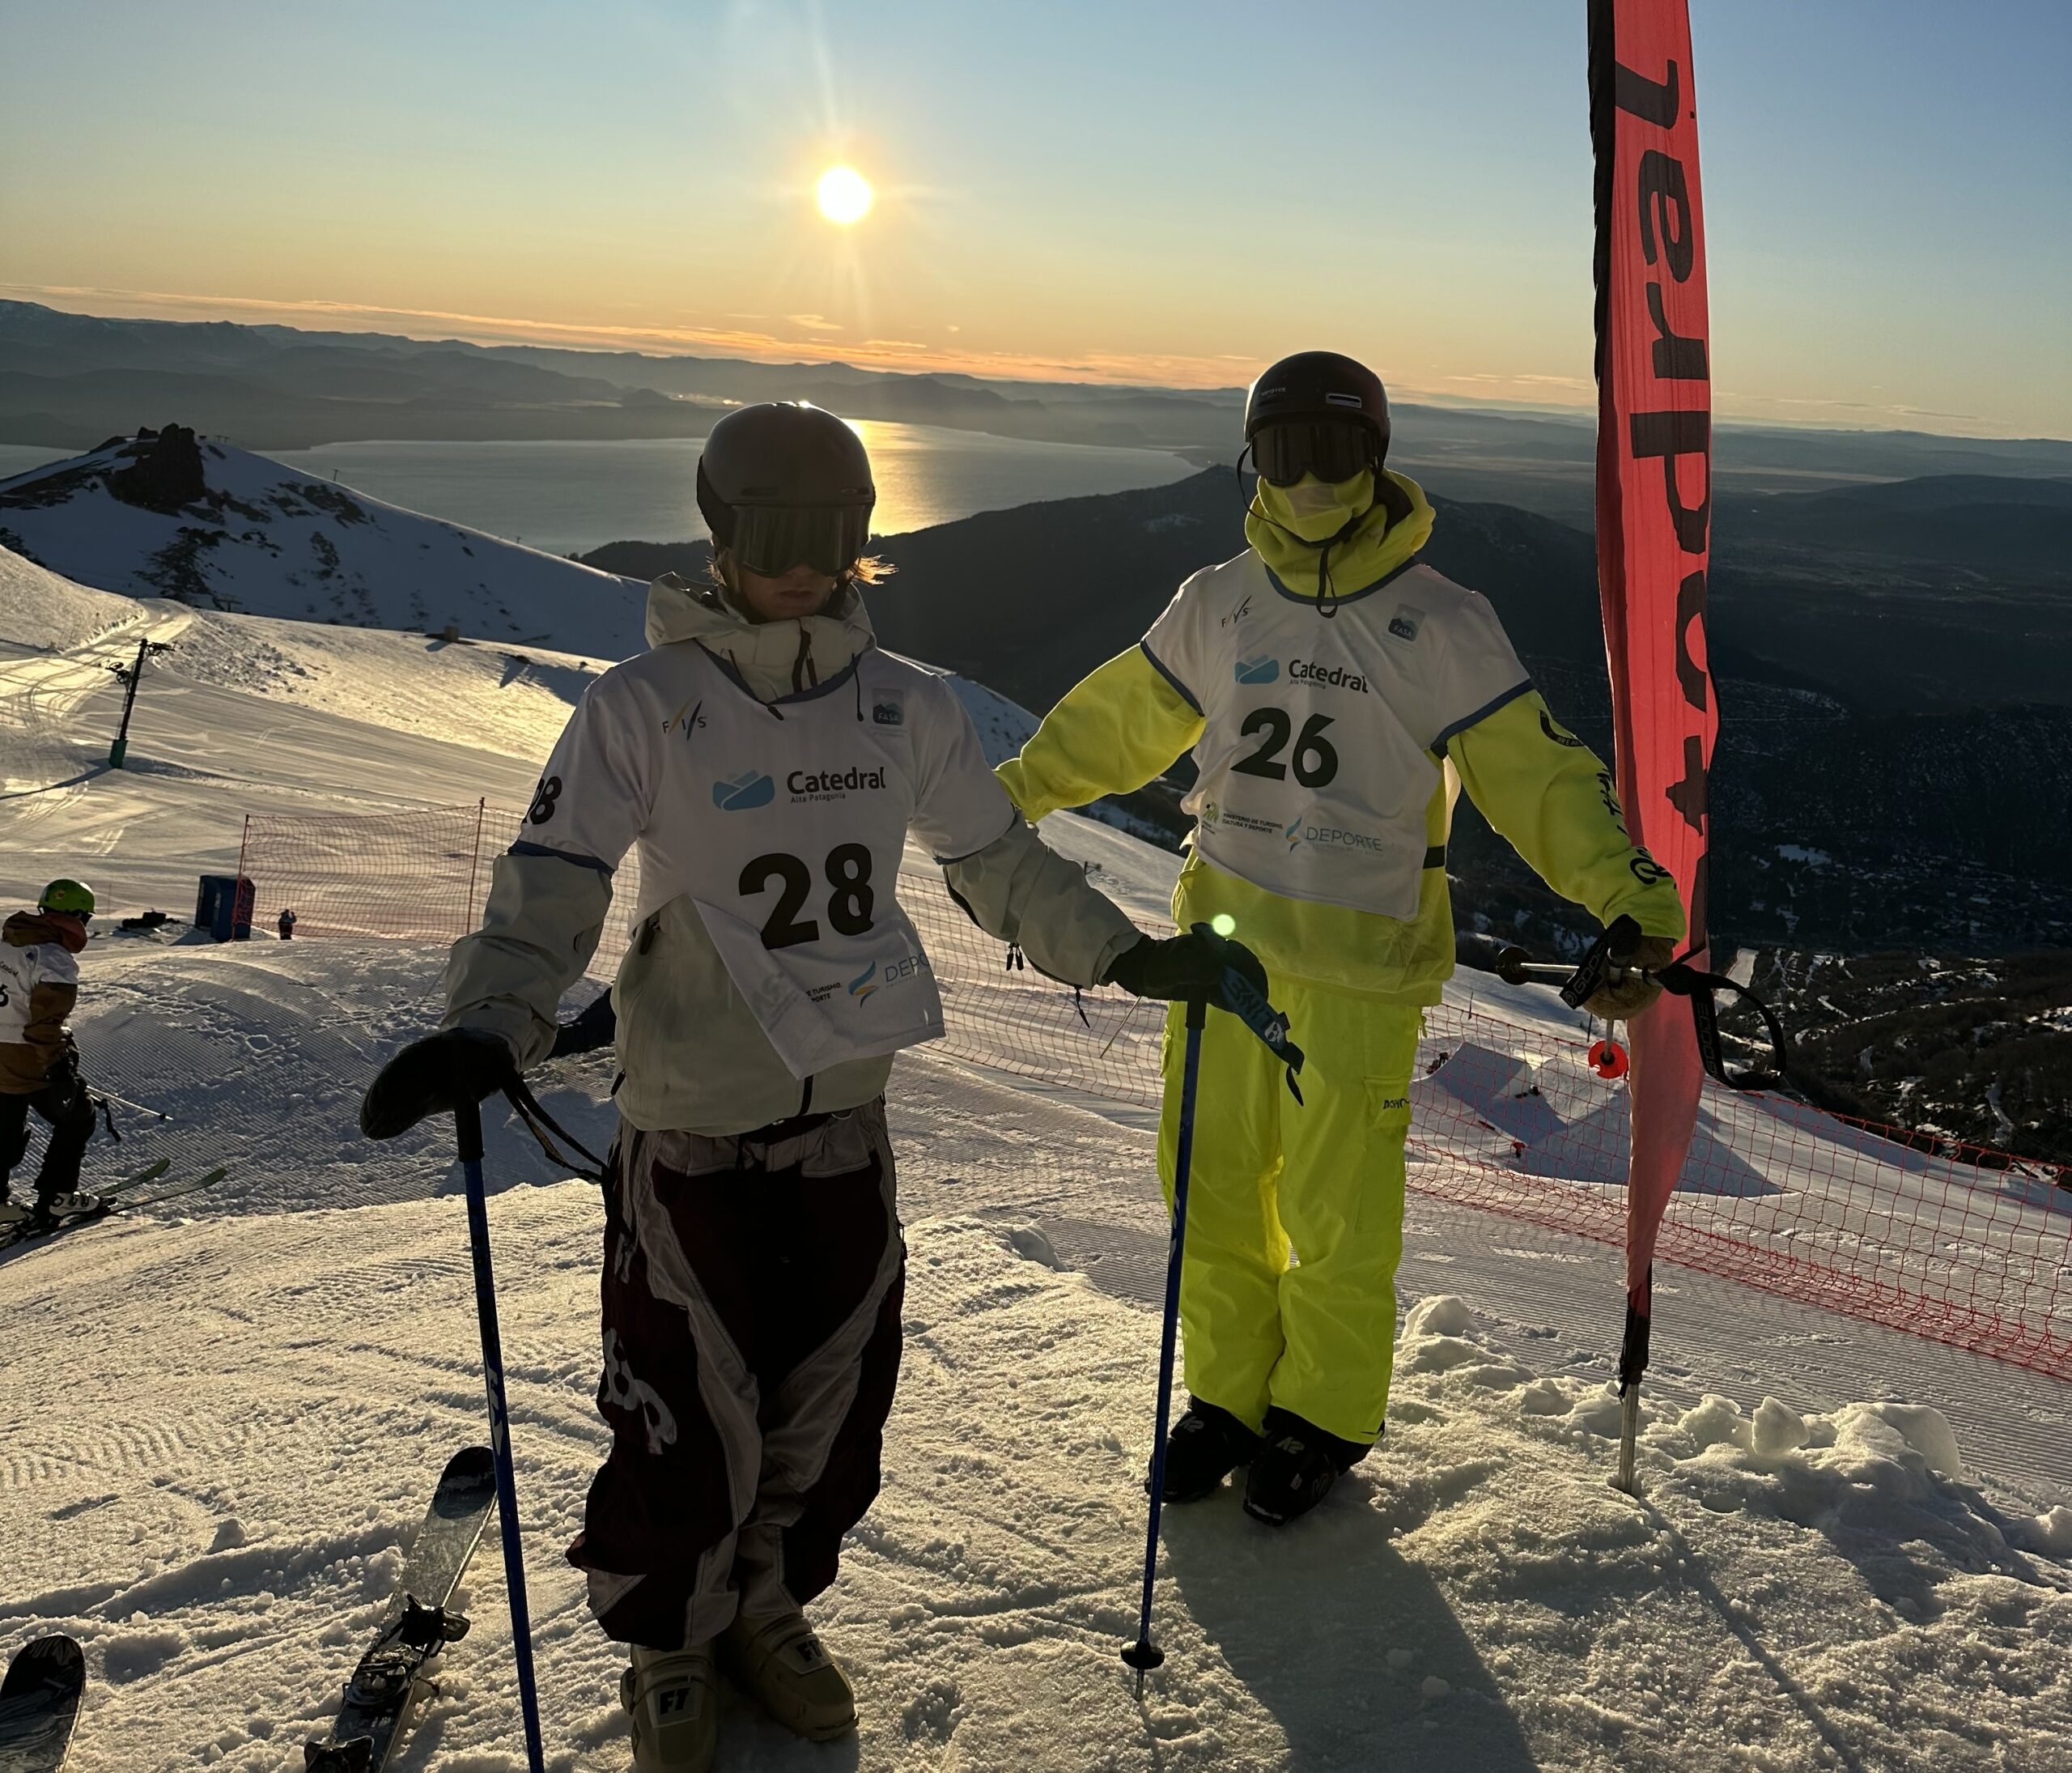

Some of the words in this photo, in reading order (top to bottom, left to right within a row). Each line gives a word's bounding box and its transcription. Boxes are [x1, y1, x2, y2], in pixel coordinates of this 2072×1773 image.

[1289, 659, 1368, 694] Catedral
[661, 708, 707, 738] FIS
[877, 712, 900, 721] FASA
[1229, 707, 1338, 788] 26
[787, 767, 885, 794] Catedral
[791, 796, 807, 804] Alta
[809, 792, 846, 802] Patagonia
[1249, 824, 1272, 834] DEPORTE
[1306, 826, 1383, 852] DEPORTE
[738, 843, 875, 950] 28
[796, 1639, 824, 1662] FT
[660, 1686, 692, 1715] FT
